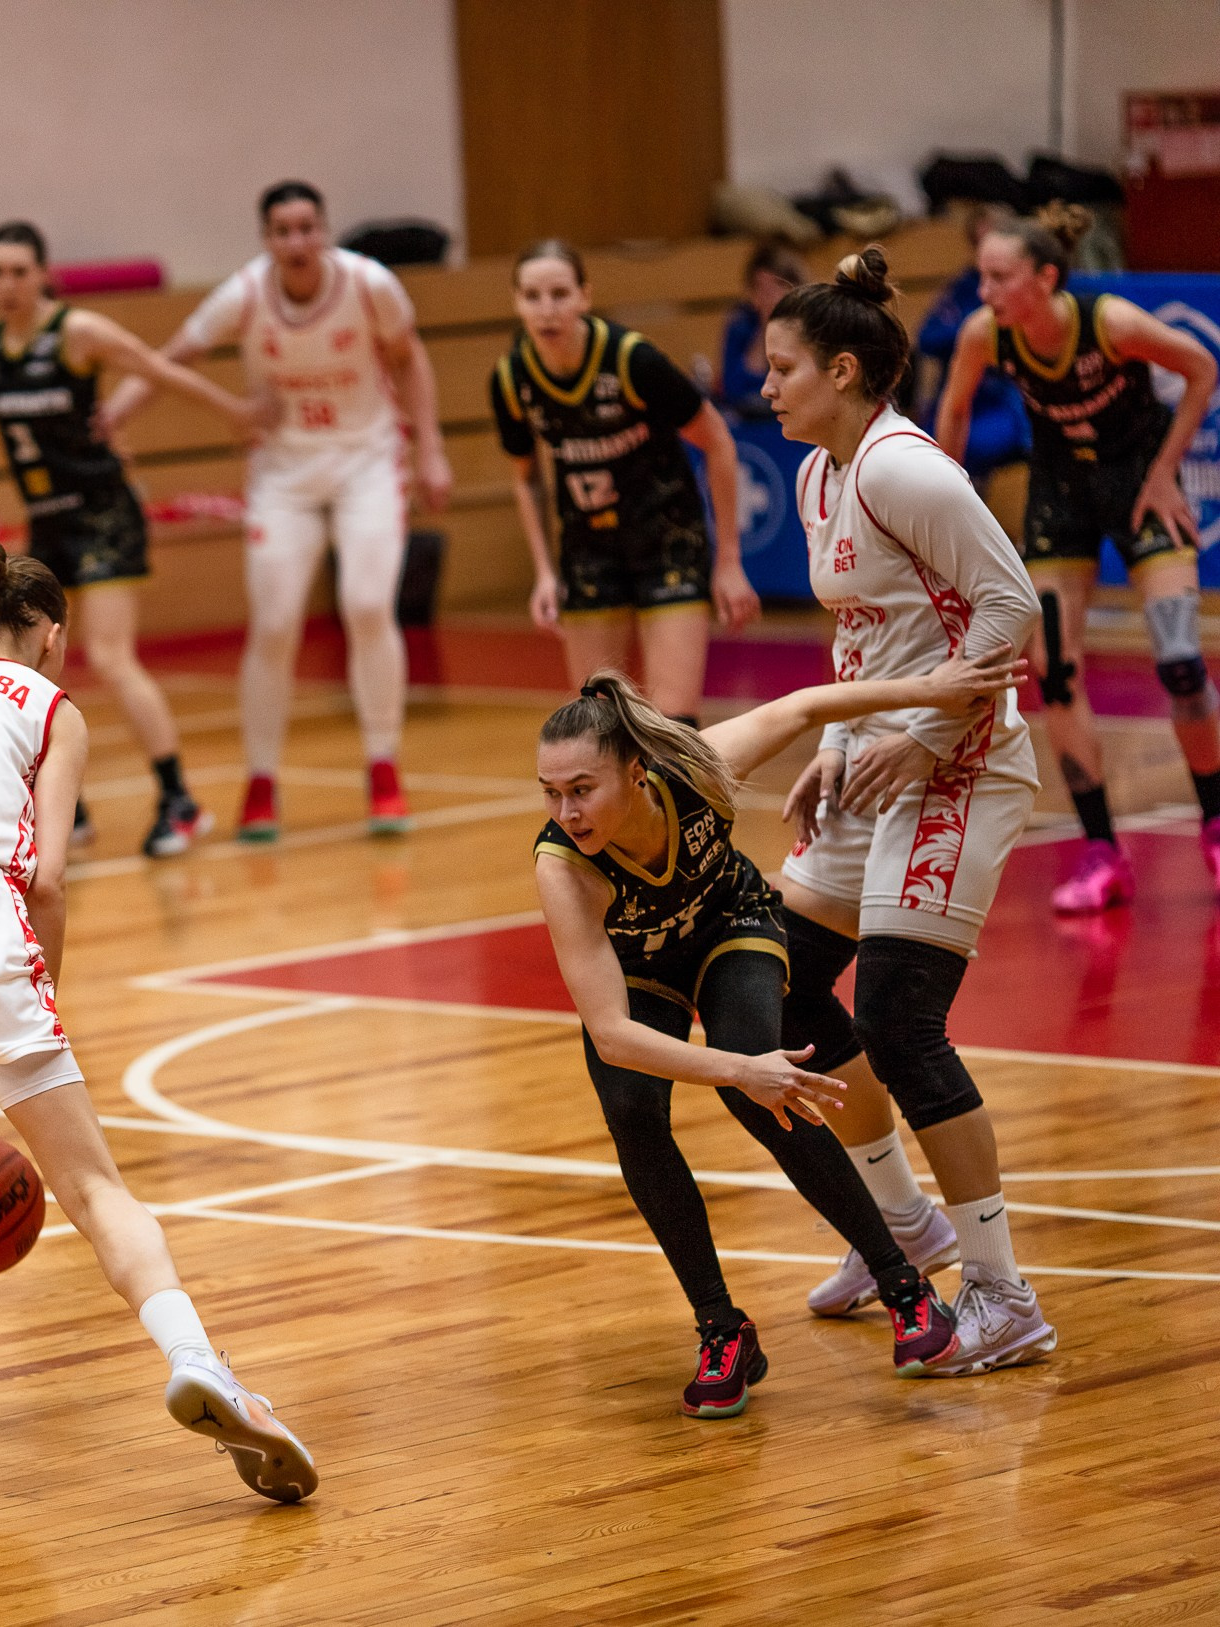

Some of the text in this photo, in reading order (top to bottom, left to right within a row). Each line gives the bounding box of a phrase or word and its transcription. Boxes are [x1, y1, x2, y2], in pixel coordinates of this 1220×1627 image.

[834, 553, 857, 574] BET
[684, 808, 716, 845] FON
[688, 821, 716, 857] BET
